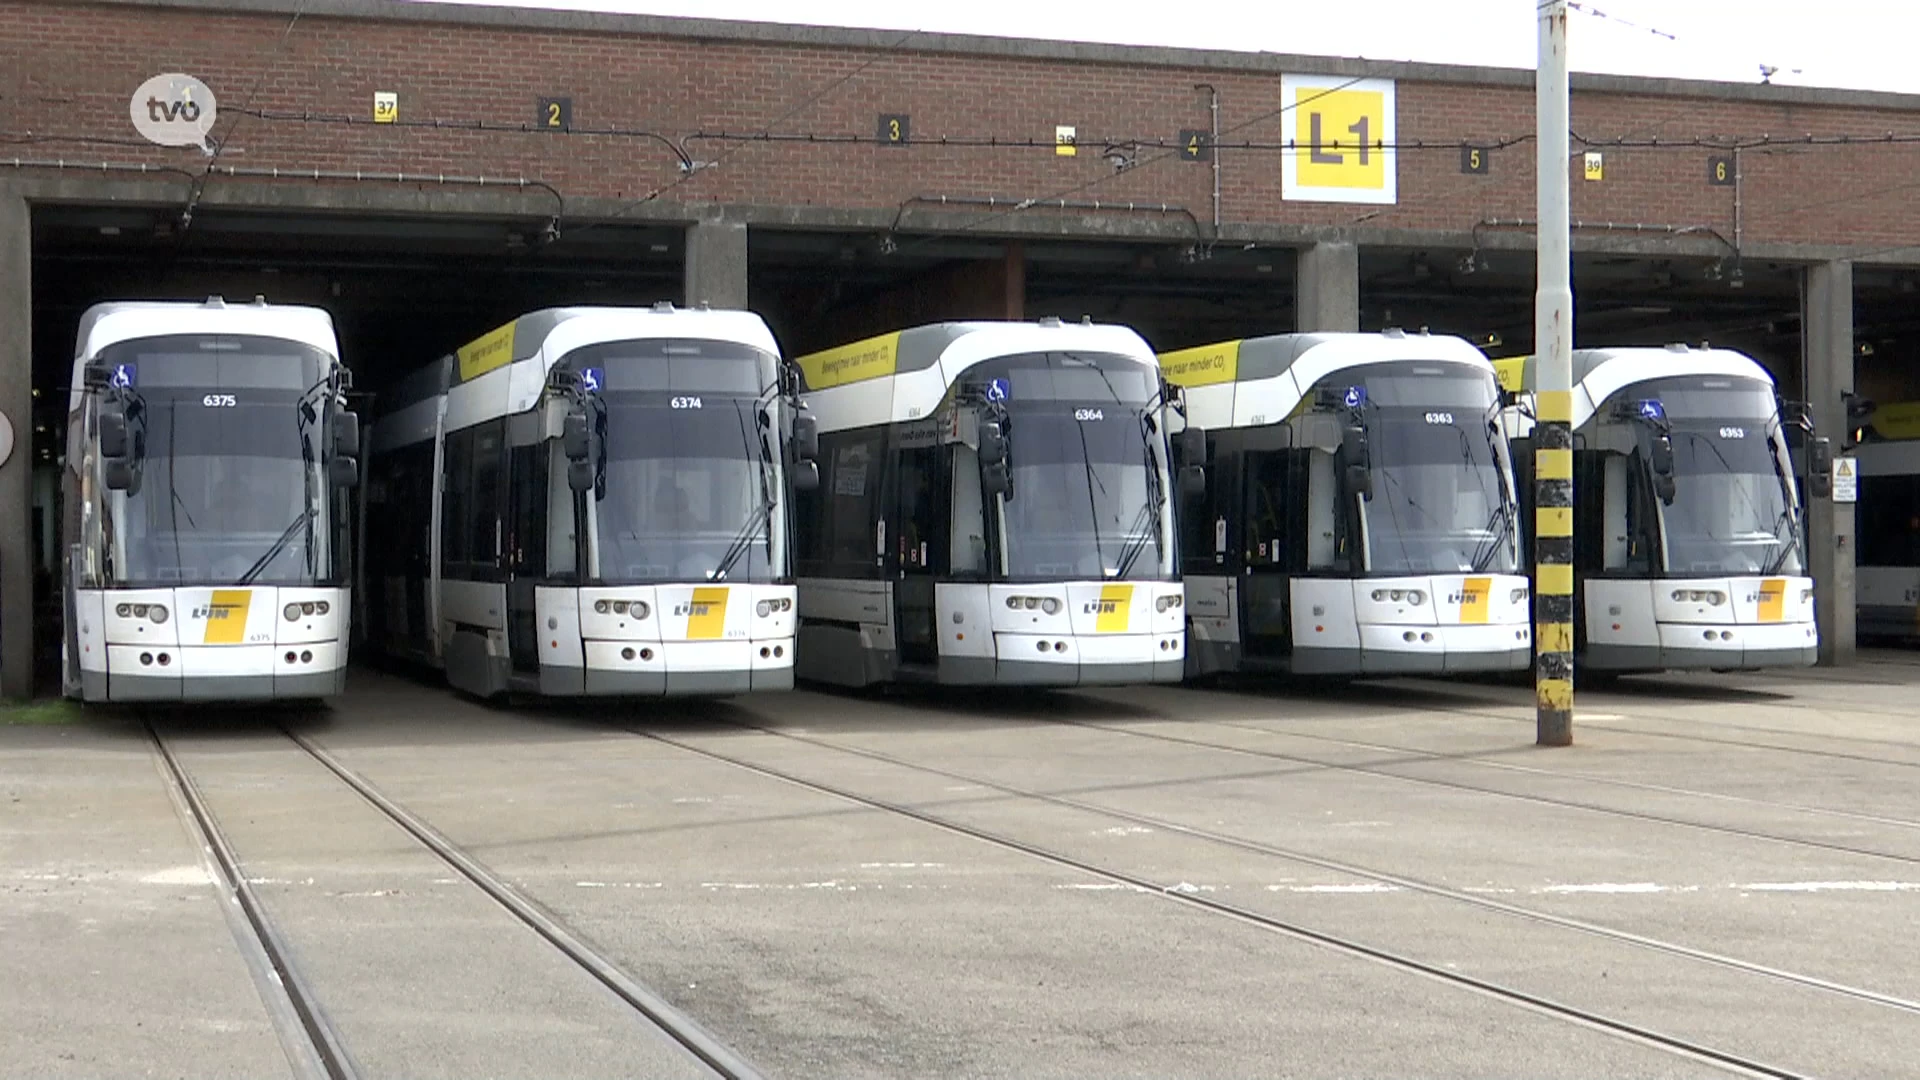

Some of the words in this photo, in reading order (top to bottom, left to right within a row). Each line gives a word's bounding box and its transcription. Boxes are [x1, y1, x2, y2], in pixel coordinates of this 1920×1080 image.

[377, 101, 394, 115] 37
[548, 103, 561, 126] 2
[889, 119, 900, 141] 3
[1187, 135, 1199, 156] 4
[1310, 112, 1369, 165] L1
[1470, 150, 1480, 169] 5
[1587, 160, 1600, 172] 39
[1716, 162, 1726, 181] 6
[1173, 361, 1188, 375] naar
[1189, 356, 1213, 371] minder
[203, 394, 236, 407] 6375
[671, 396, 702, 409] 6374
[1075, 409, 1103, 421] 6364
[1425, 412, 1453, 424] 6363
[1719, 427, 1744, 439] 6353
[250, 633, 270, 642] 6375
